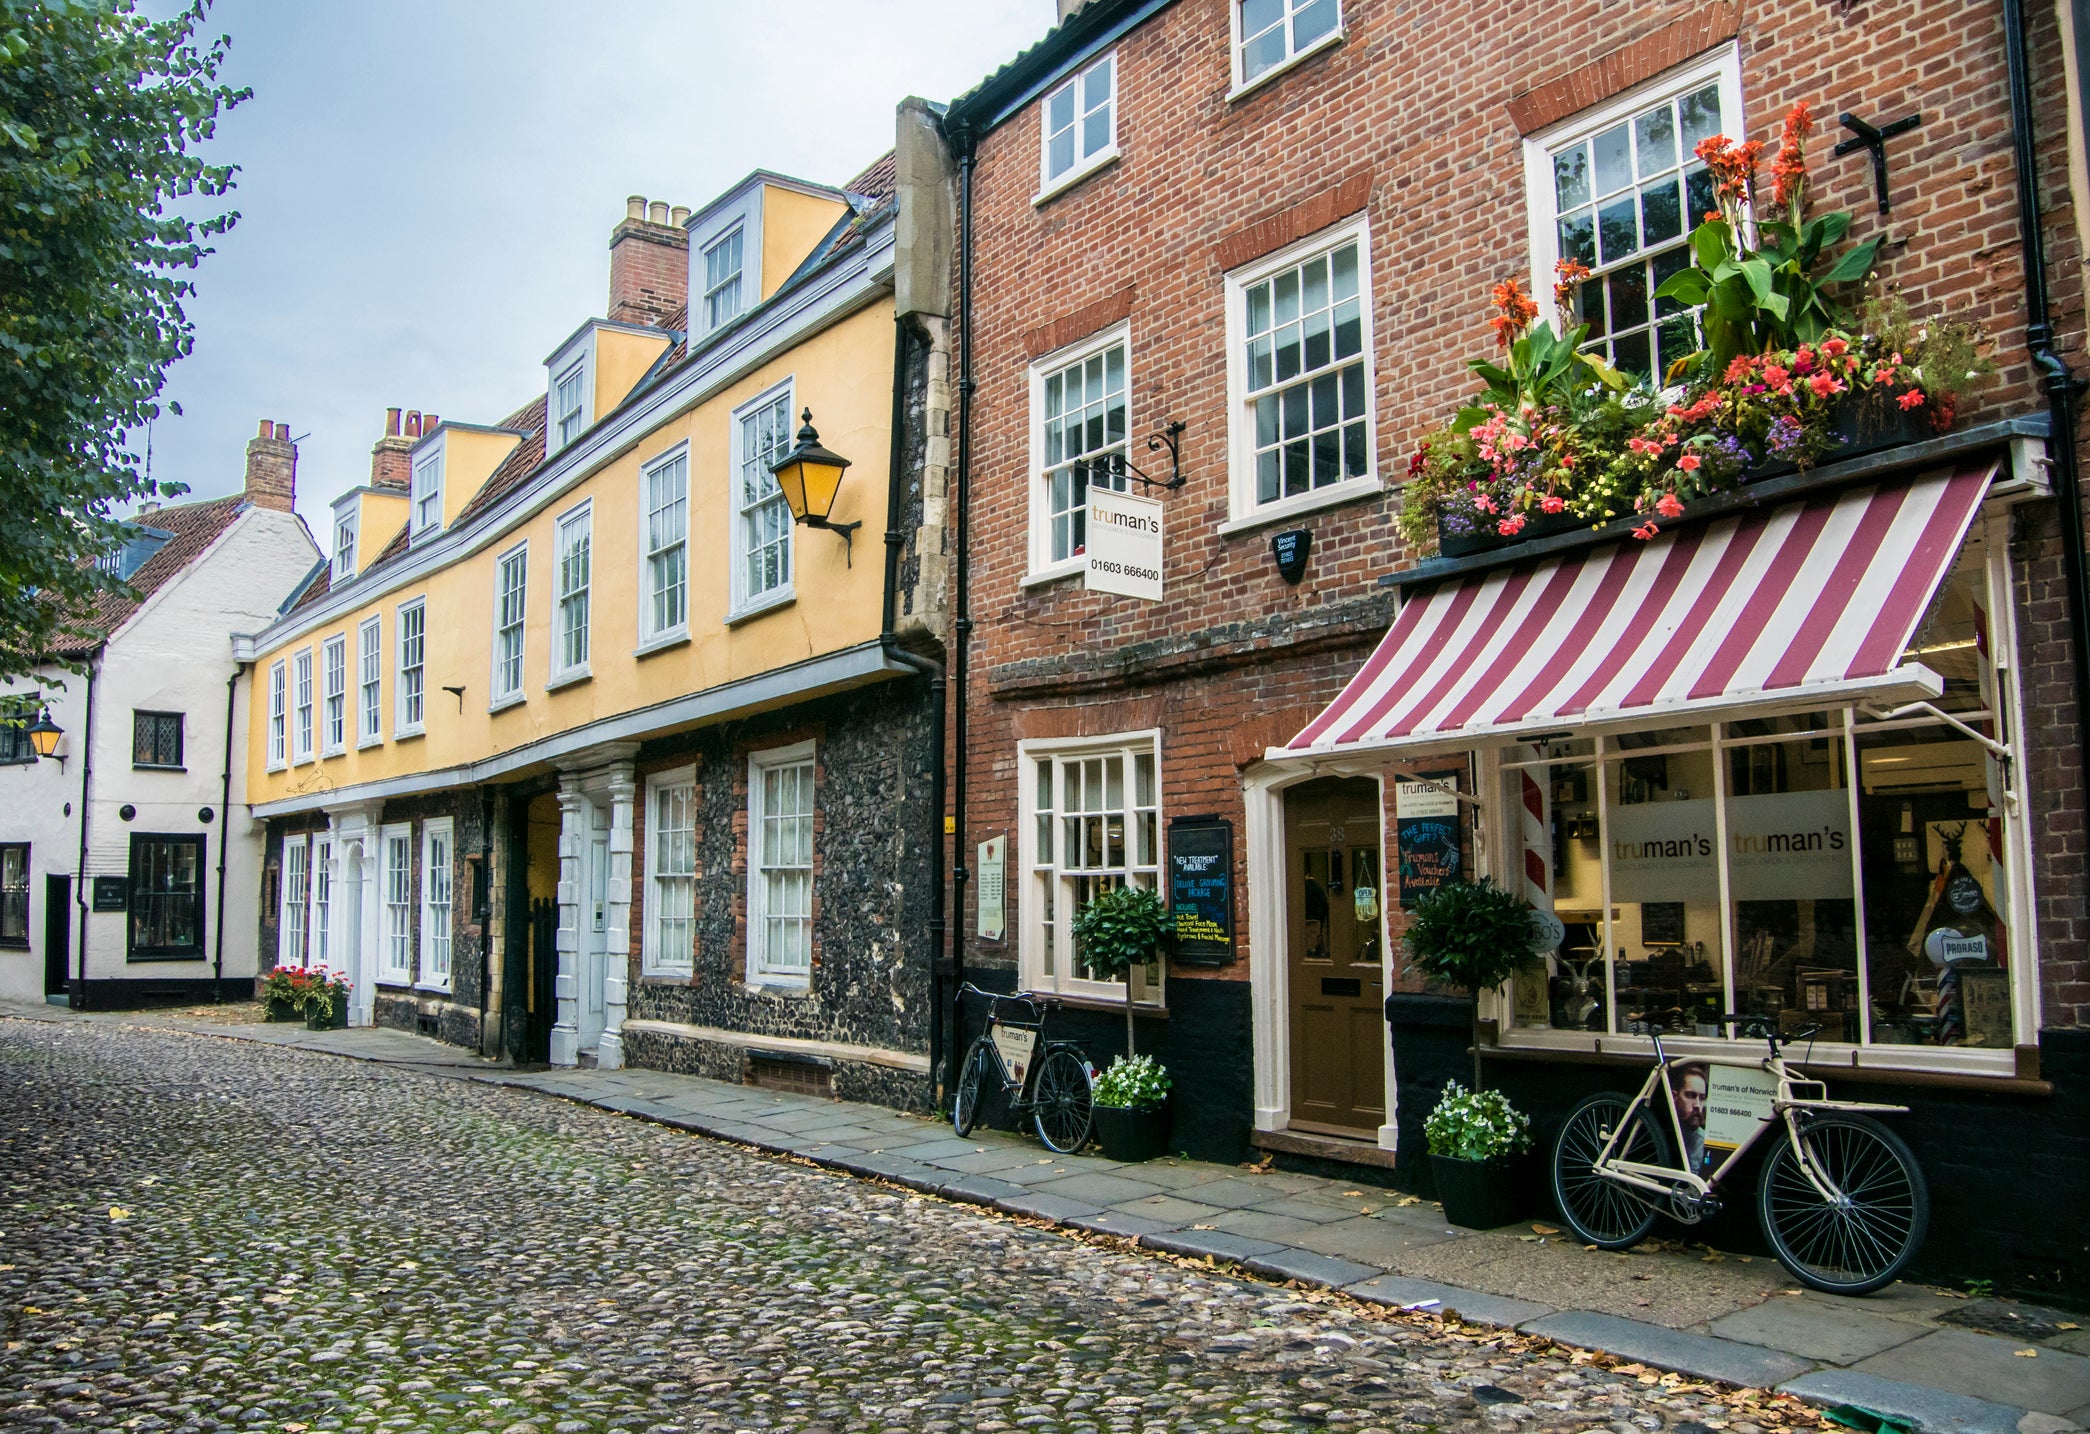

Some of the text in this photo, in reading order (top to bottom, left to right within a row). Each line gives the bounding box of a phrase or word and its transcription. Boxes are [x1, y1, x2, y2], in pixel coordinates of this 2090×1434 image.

[1091, 505, 1159, 533] truman's
[1091, 559, 1159, 580] 01603 666400
[1401, 823, 1452, 840] THE PERFECT
[1614, 833, 1711, 860] truman's
[1734, 826, 1844, 854] truman's
[1358, 888, 1372, 897] OPEN
[1946, 941, 1983, 955] PRORASO
[1001, 1029, 1028, 1043] truman's
[1712, 1083, 1740, 1093] truman's
[1749, 1087, 1778, 1097] Norwich
[1710, 1106, 1752, 1118] 01603 666400
